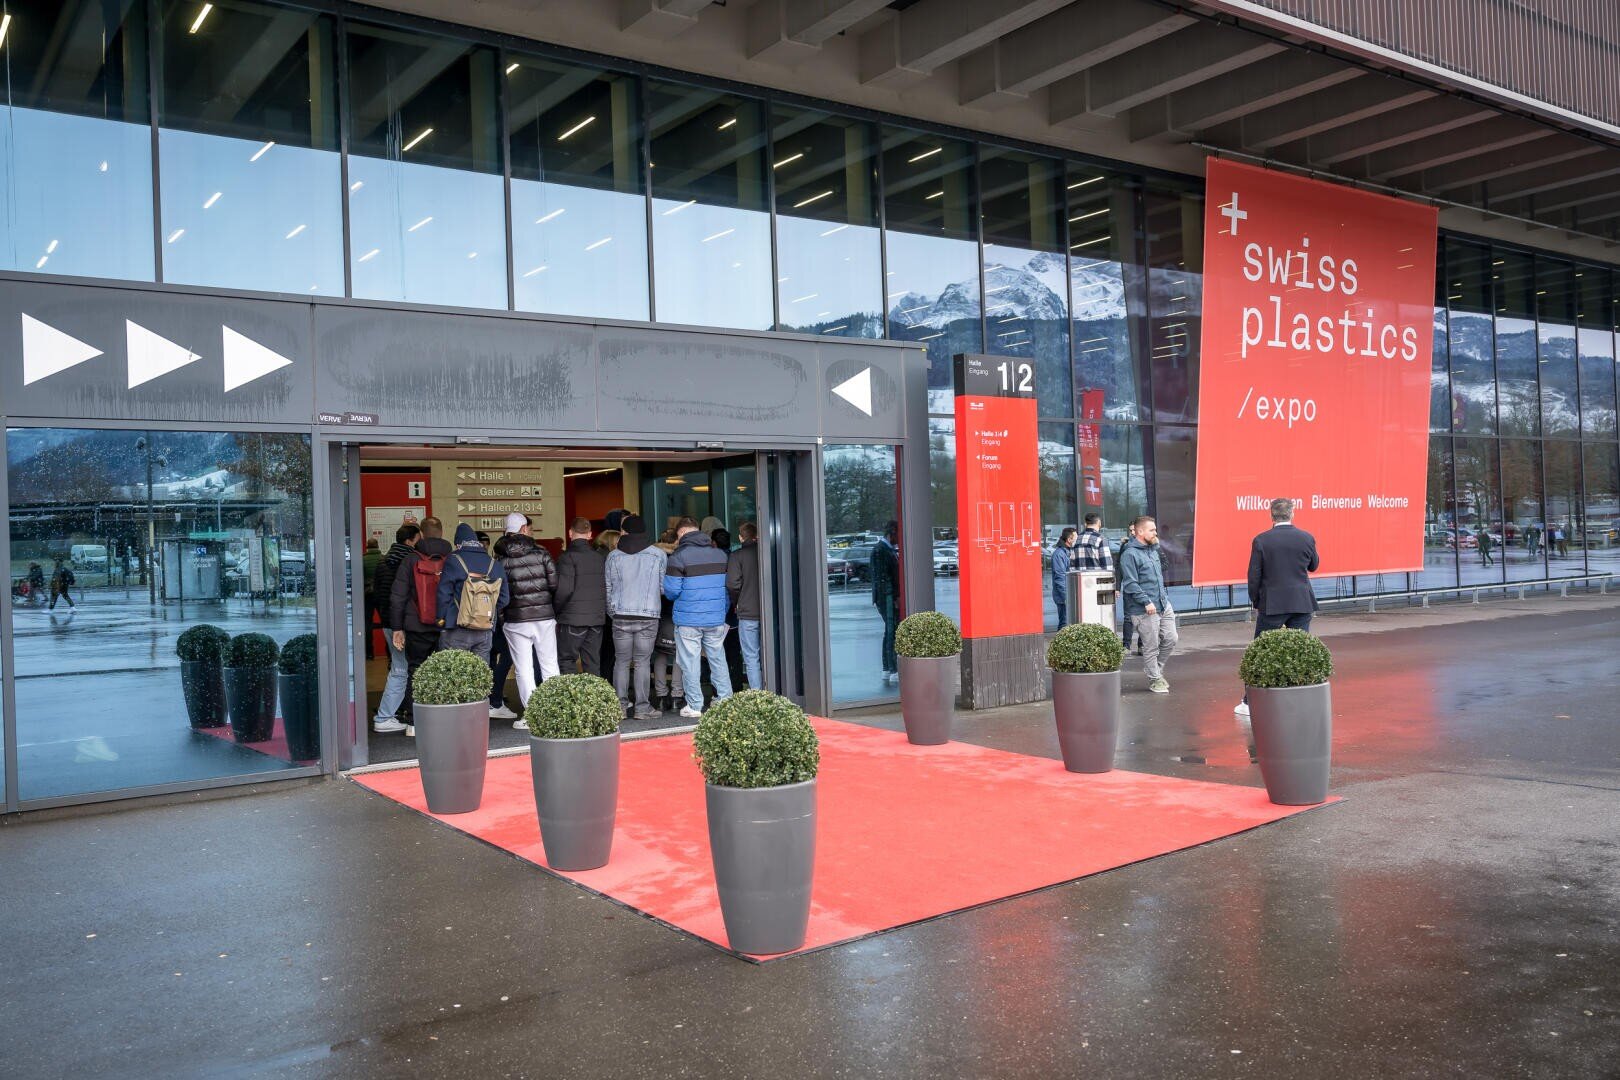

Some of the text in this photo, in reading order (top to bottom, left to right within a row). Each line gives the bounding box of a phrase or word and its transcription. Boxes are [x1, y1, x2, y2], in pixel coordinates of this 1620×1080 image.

[1243, 237, 1358, 294] swiss
[1241, 295, 1418, 361] plastics
[968, 359, 982, 367] Halle
[968, 367, 989, 376] Eingang
[1237, 387, 1317, 429] /expo
[479, 471, 504, 480] Halle
[507, 471, 512, 480] 1
[480, 487, 515, 496] Galerie
[1311, 494, 1362, 509] Bienvenue
[1367, 494, 1409, 508] Welcome
[480, 503, 511, 512] Hallen
